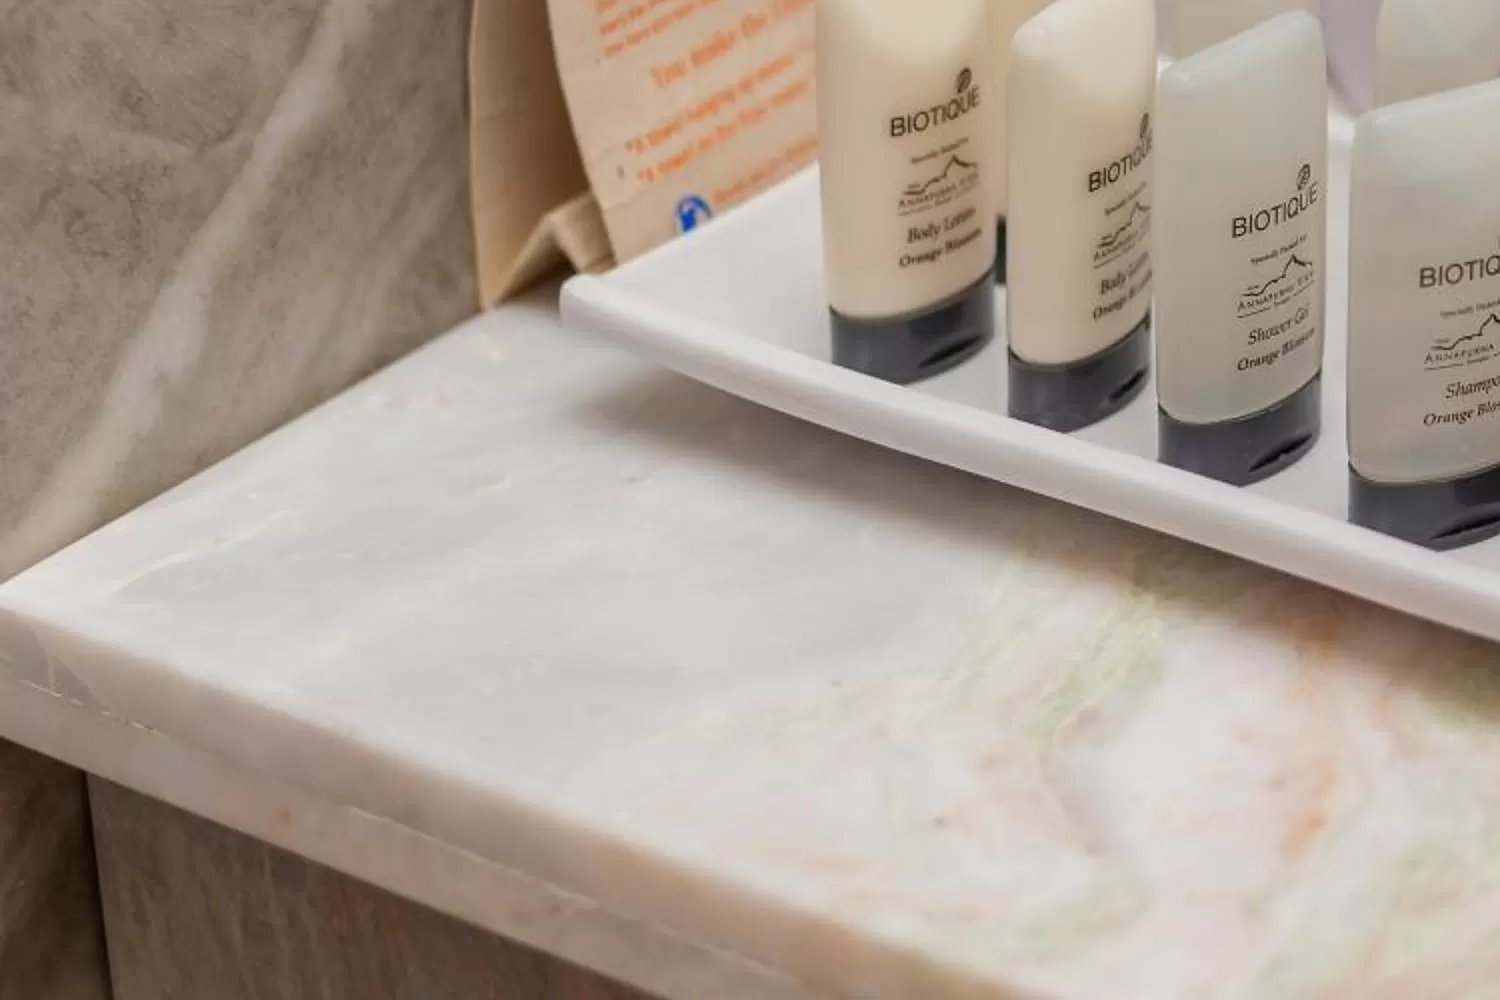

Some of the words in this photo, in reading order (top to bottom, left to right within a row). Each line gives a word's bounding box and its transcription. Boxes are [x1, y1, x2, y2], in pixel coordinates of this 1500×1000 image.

[890, 85, 981, 138] BIOTIQUE
[1231, 181, 1318, 239] BIOTIQUE
[907, 222, 942, 244] Body
[1247, 318, 1293, 346] Shower
[1237, 350, 1281, 372] Orange
[1423, 409, 1475, 428] Orange
